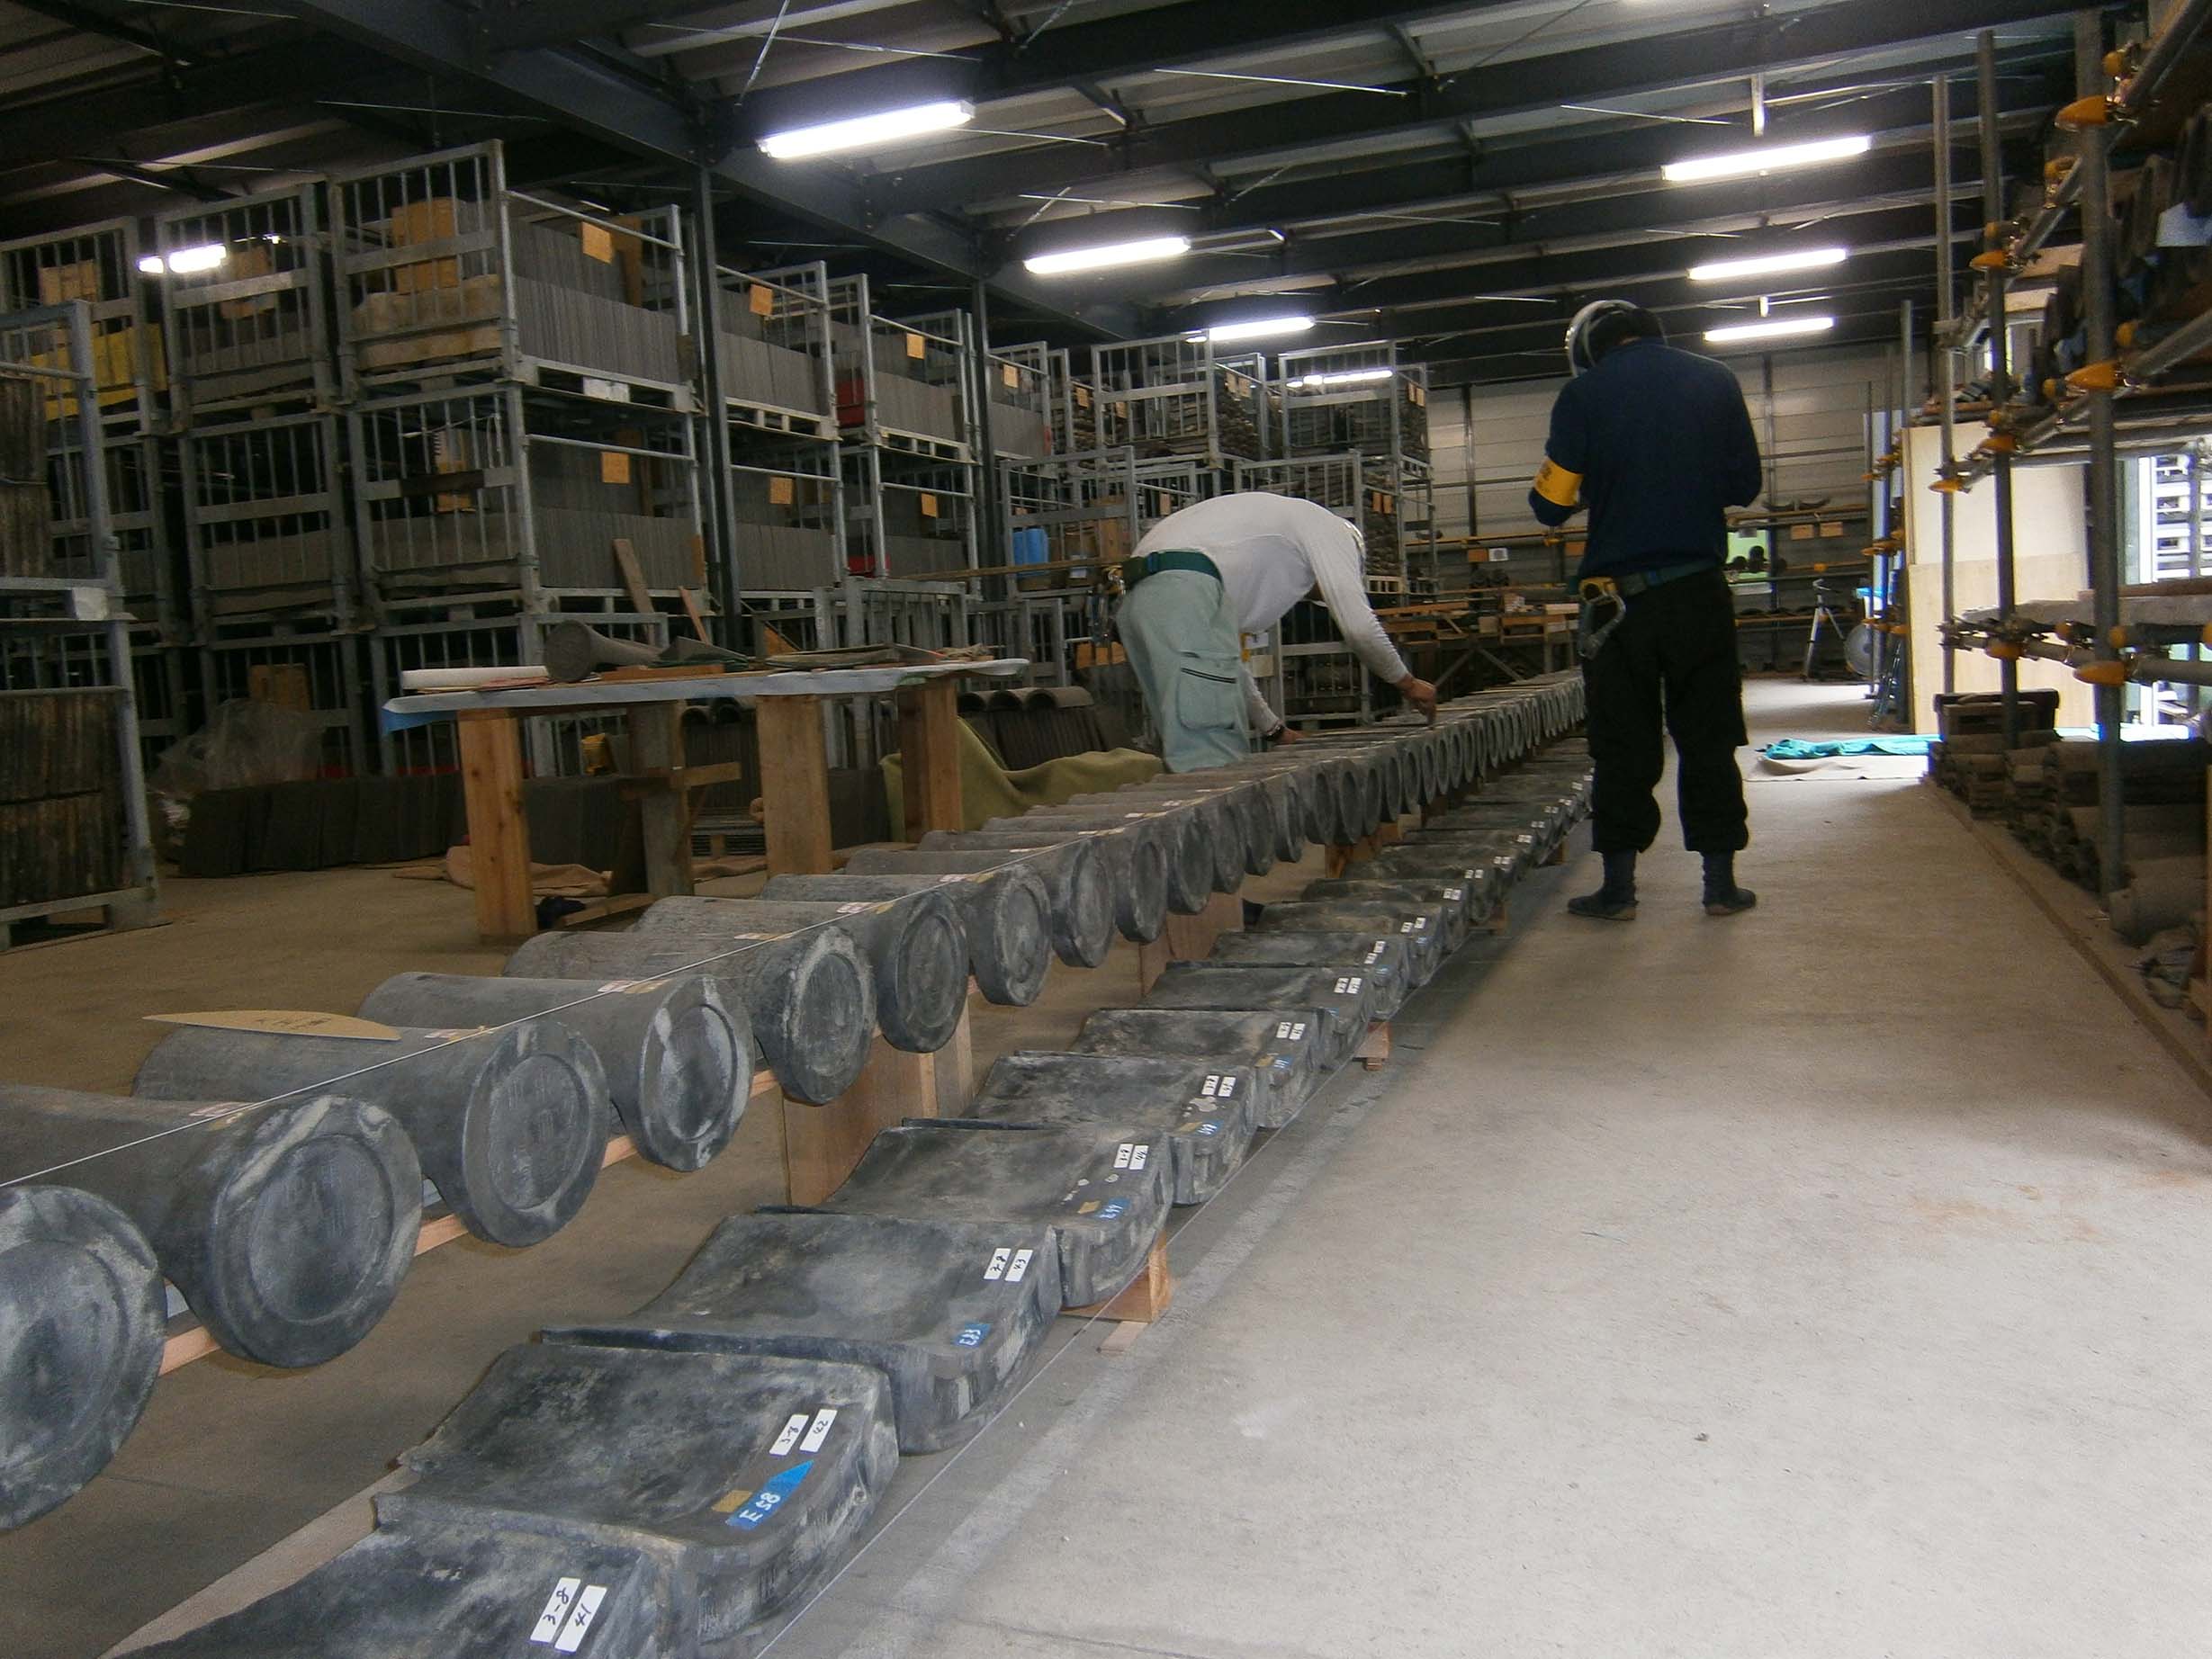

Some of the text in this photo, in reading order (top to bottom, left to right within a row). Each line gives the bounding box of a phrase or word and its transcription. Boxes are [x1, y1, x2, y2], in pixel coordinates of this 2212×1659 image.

[1013, 1258, 1027, 1270] 43
[813, 1420, 830, 1436] 42
[542, 1586, 571, 1626] 3-8
[574, 1604, 593, 1627] 41
